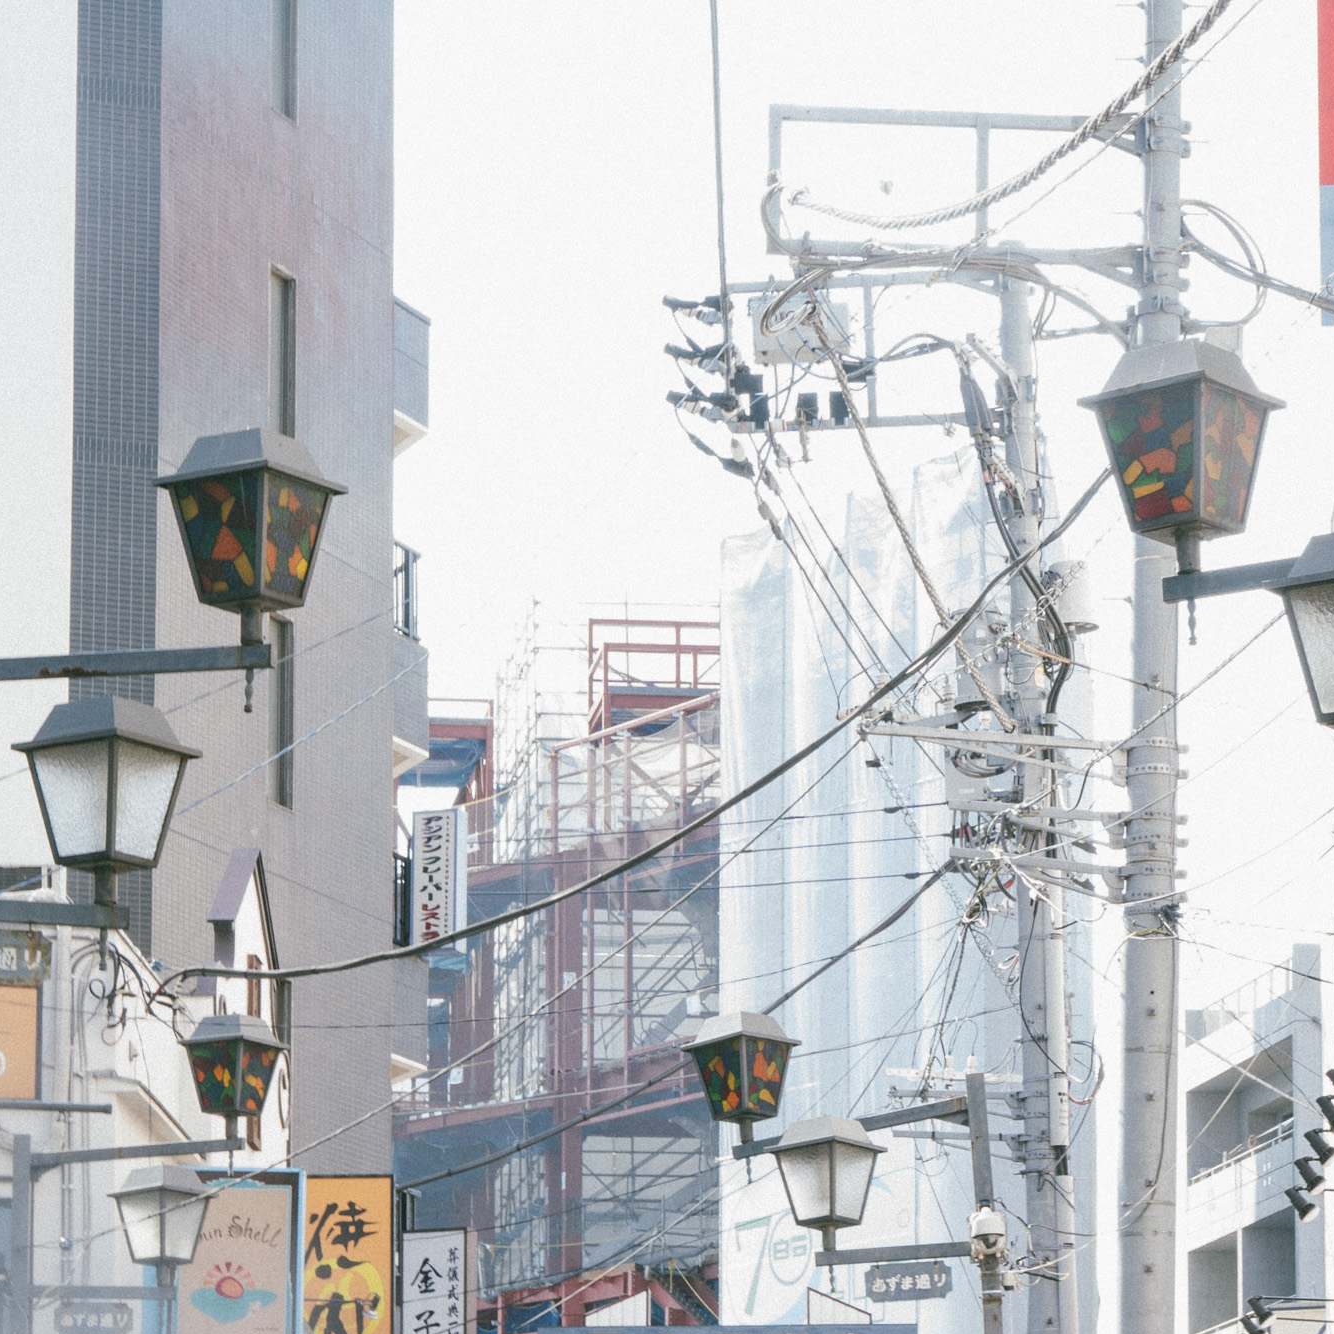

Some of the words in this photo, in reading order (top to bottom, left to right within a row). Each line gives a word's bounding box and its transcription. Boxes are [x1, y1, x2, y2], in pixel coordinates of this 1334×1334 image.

[228, 1215, 282, 1248] Shell
[871, 1273, 948, 1294] あずま通り
